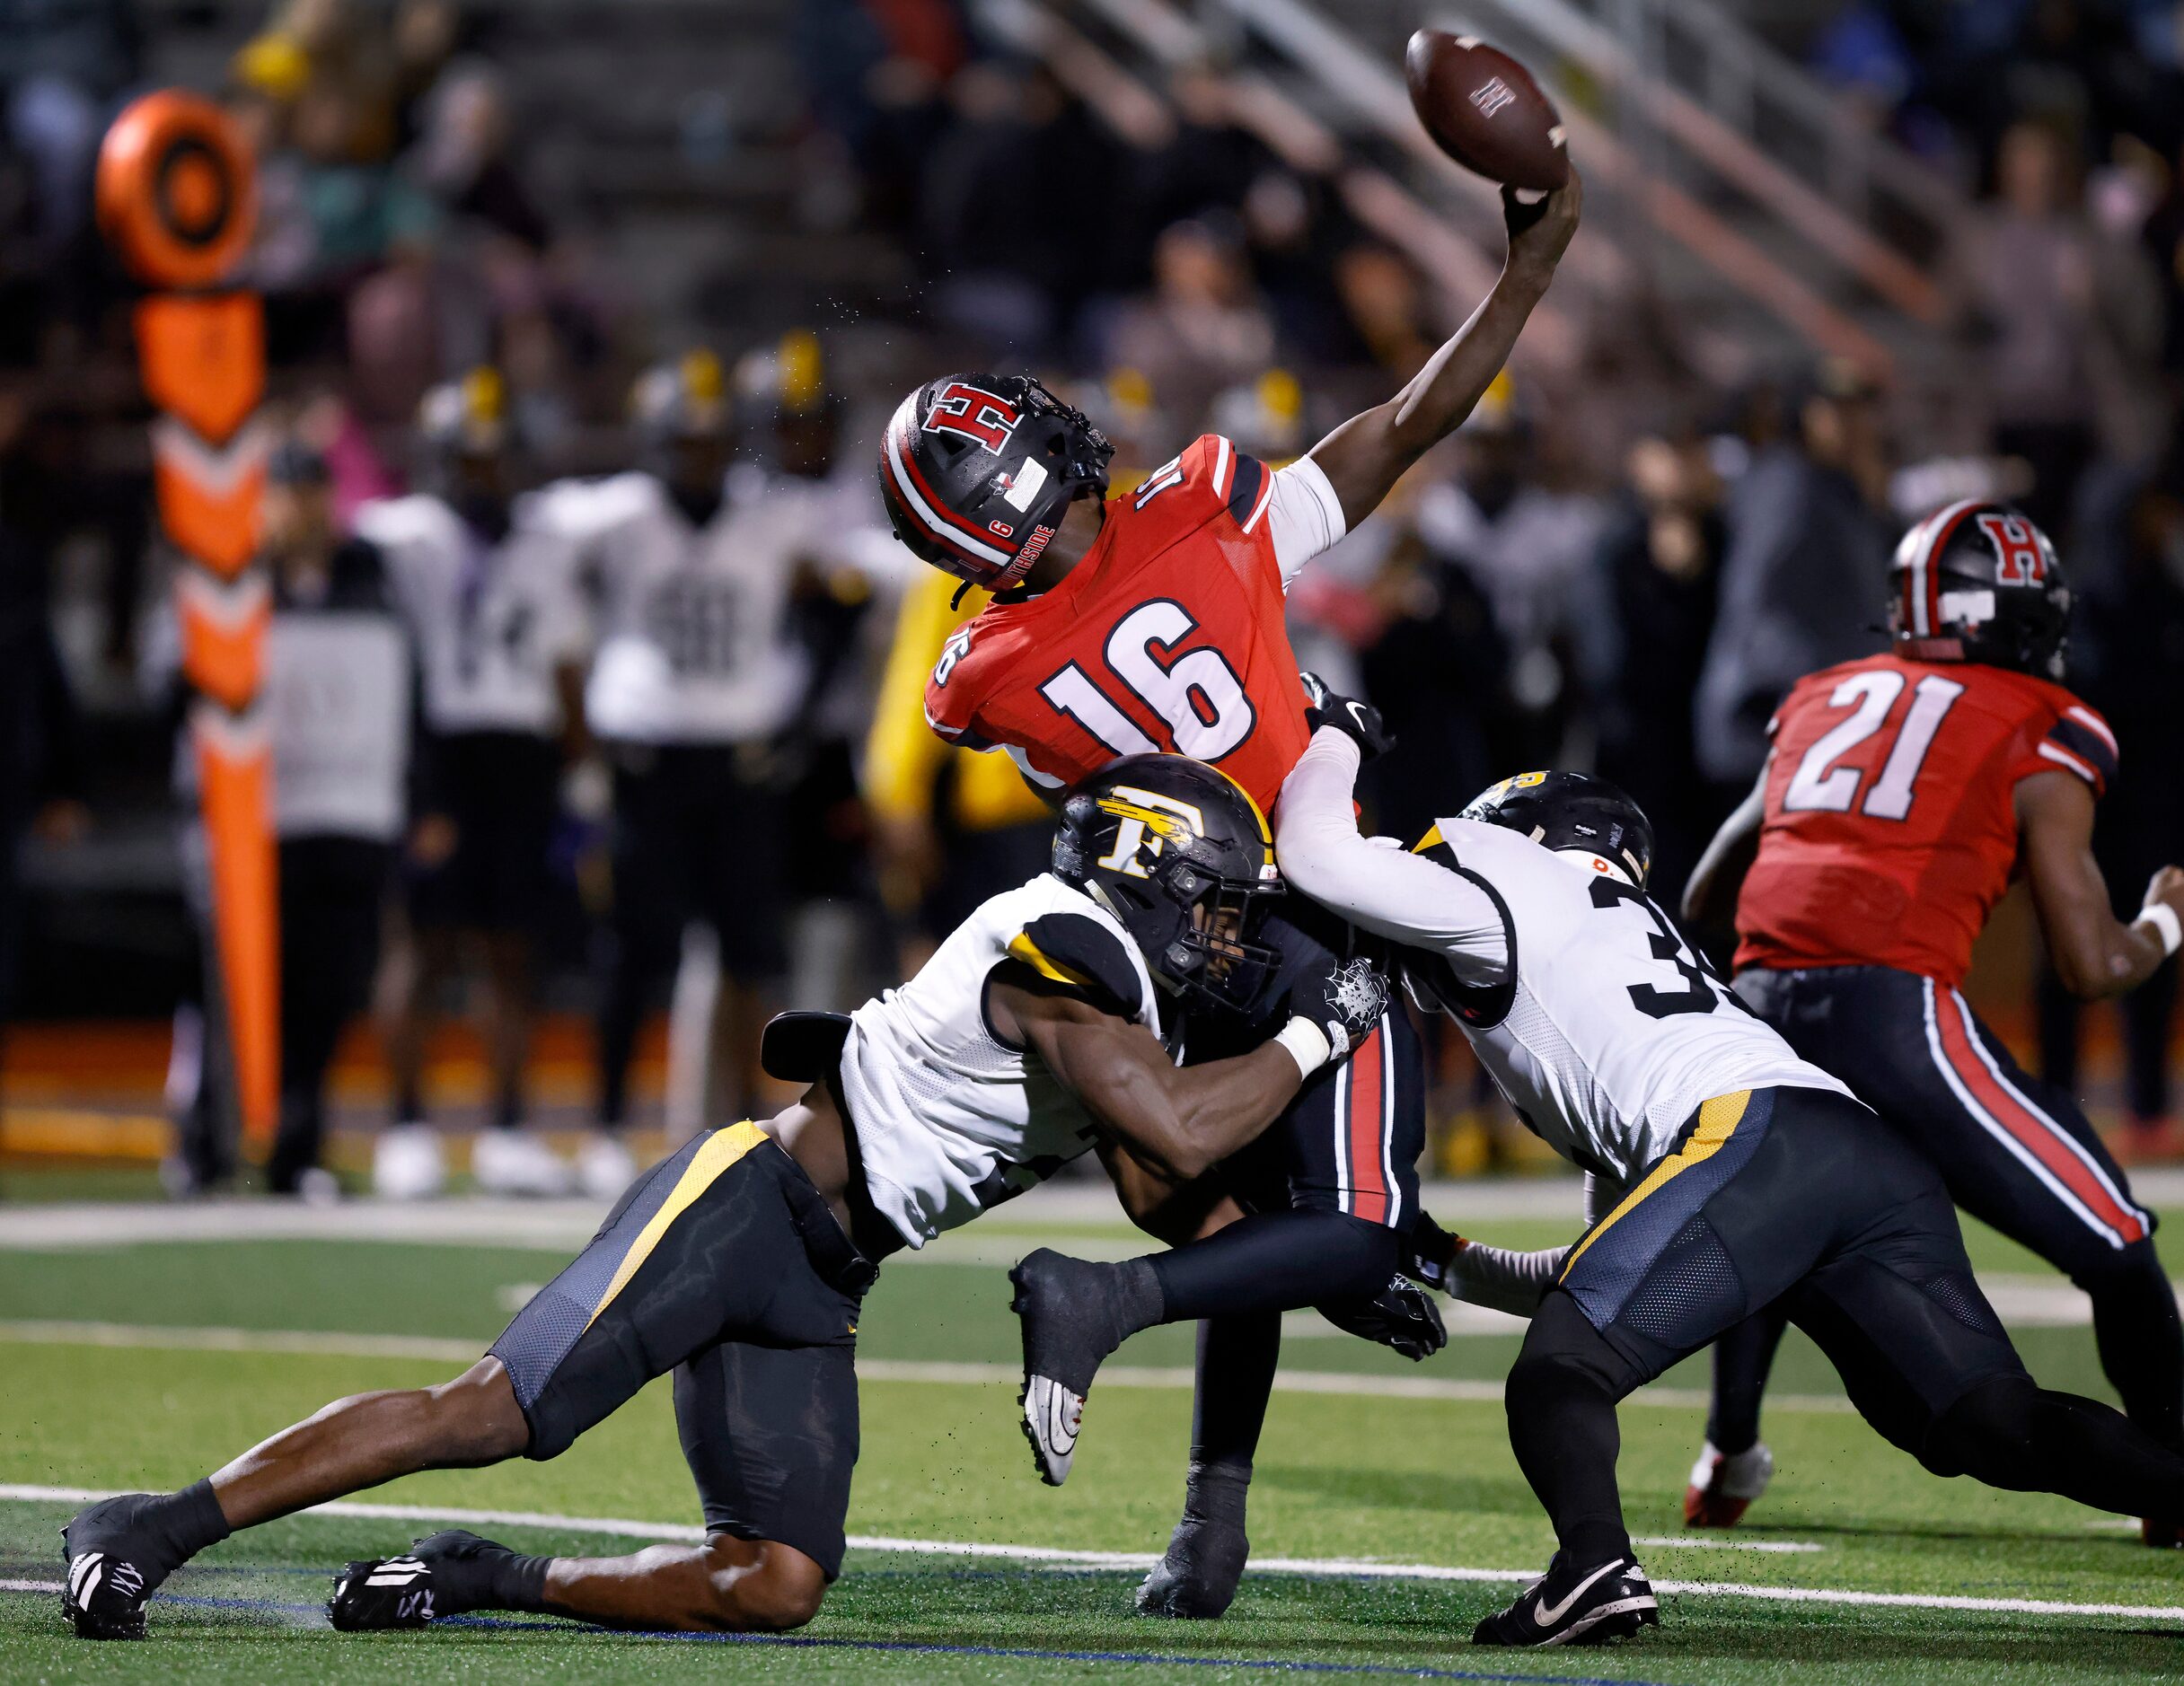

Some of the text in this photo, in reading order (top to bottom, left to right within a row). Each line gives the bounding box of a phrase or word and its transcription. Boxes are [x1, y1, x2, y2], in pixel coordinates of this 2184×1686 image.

[1468, 76, 1518, 119] H
[920, 382, 1026, 457] H
[988, 519, 1014, 538] 6
[1975, 514, 2049, 589] H
[1036, 597, 1257, 765] 16
[1783, 669, 1967, 822] 21
[1096, 785, 1205, 880] F
